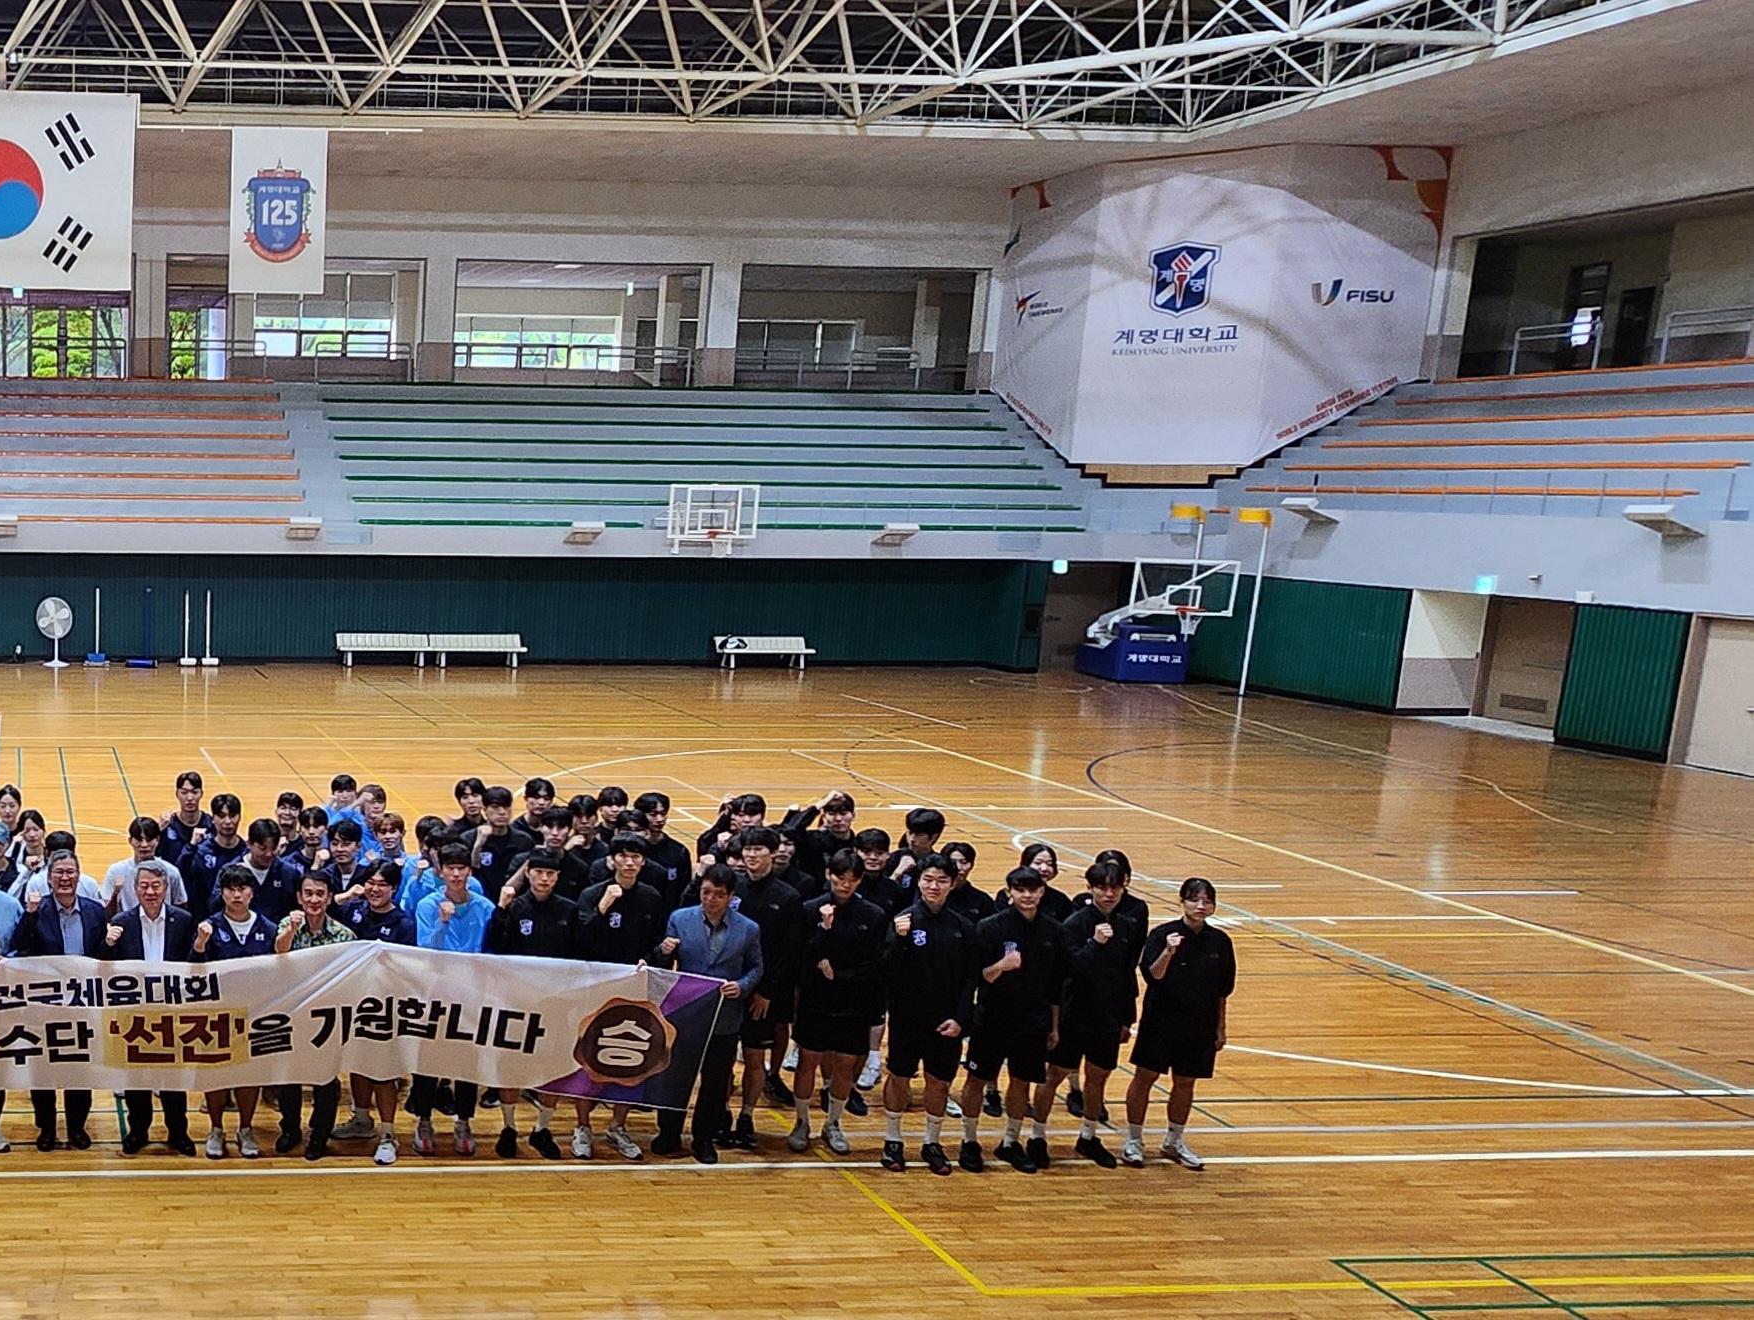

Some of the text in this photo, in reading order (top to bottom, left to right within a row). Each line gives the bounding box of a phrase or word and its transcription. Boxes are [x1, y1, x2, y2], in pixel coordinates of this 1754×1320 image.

[262, 199, 298, 226] 125
[1158, 268, 1174, 282] 계
[1190, 278, 1205, 293] 명
[1346, 289, 1395, 304] FISU
[1113, 324, 1239, 345] 계명대학교
[1112, 344, 1238, 357] KEIMYUNG UNIVERSITY
[310, 996, 546, 1054] 기원합니다
[597, 1018, 653, 1068] 승
